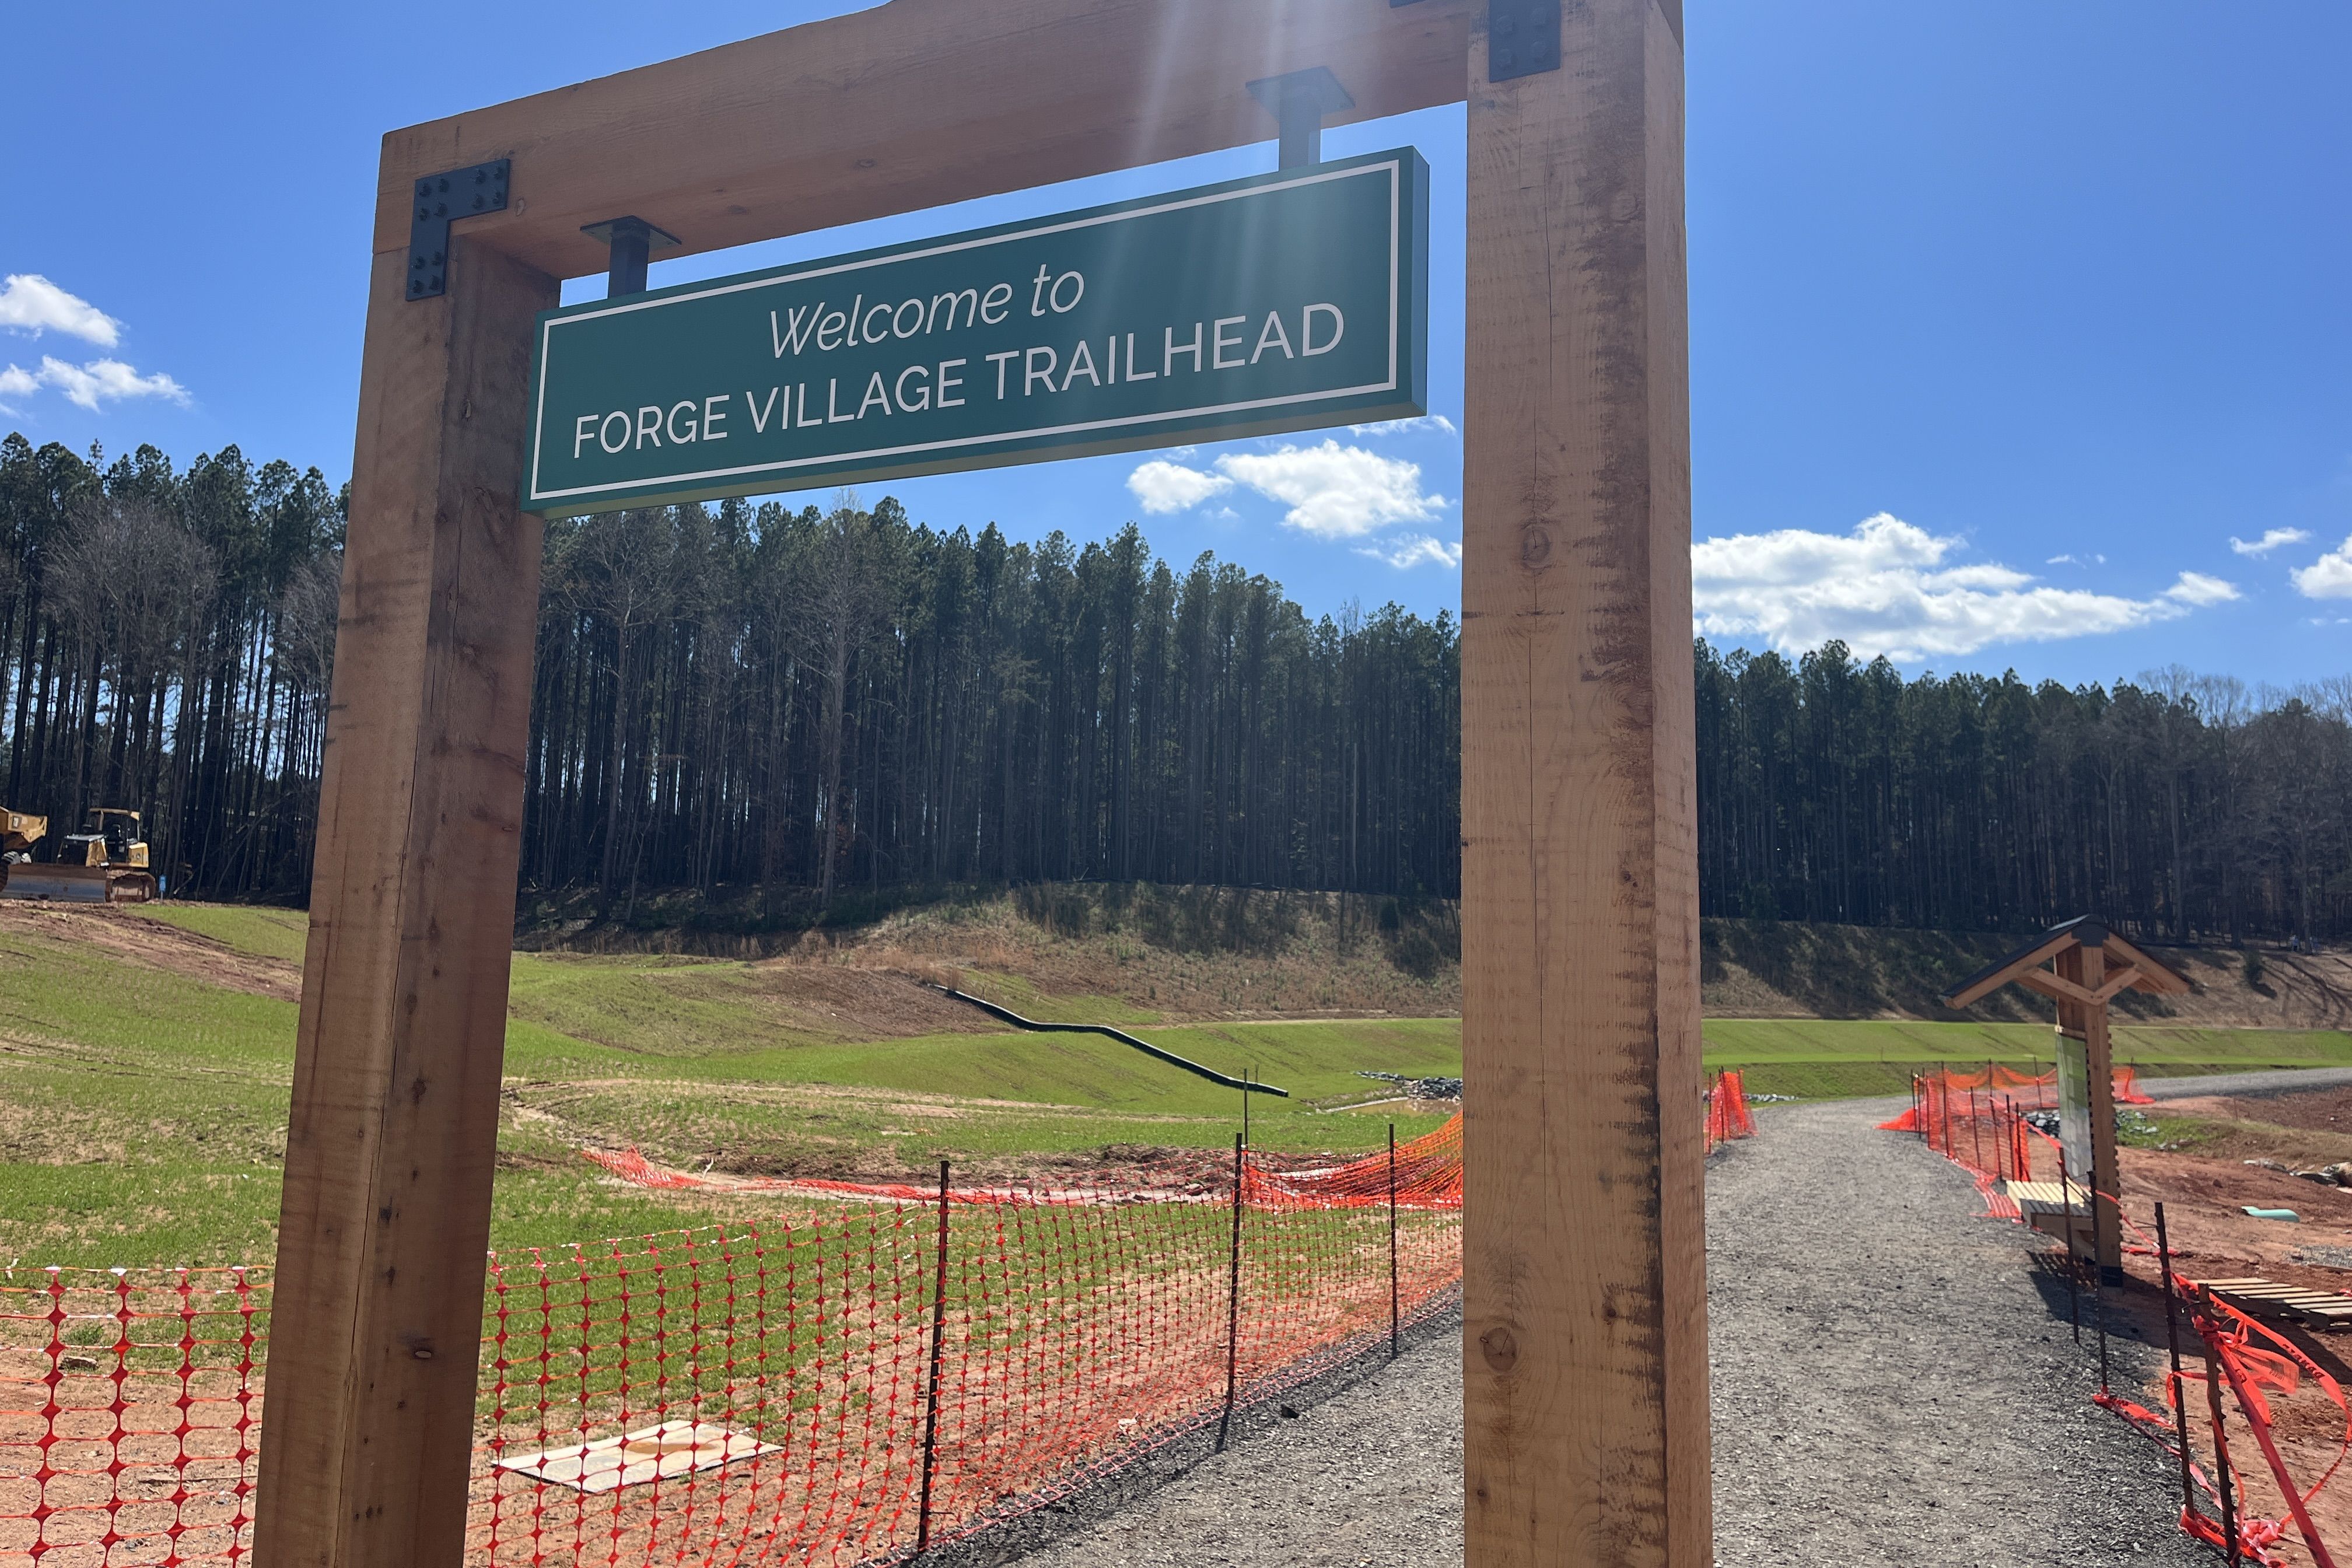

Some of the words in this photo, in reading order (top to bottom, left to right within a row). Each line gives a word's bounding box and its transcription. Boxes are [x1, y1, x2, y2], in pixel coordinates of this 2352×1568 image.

[769, 283, 1013, 359] Welcome
[1030, 263, 1085, 318] to
[573, 394, 730, 459] FORGE
[745, 358, 967, 433] VILLAGE
[985, 303, 1345, 400] TRAILHEAD
